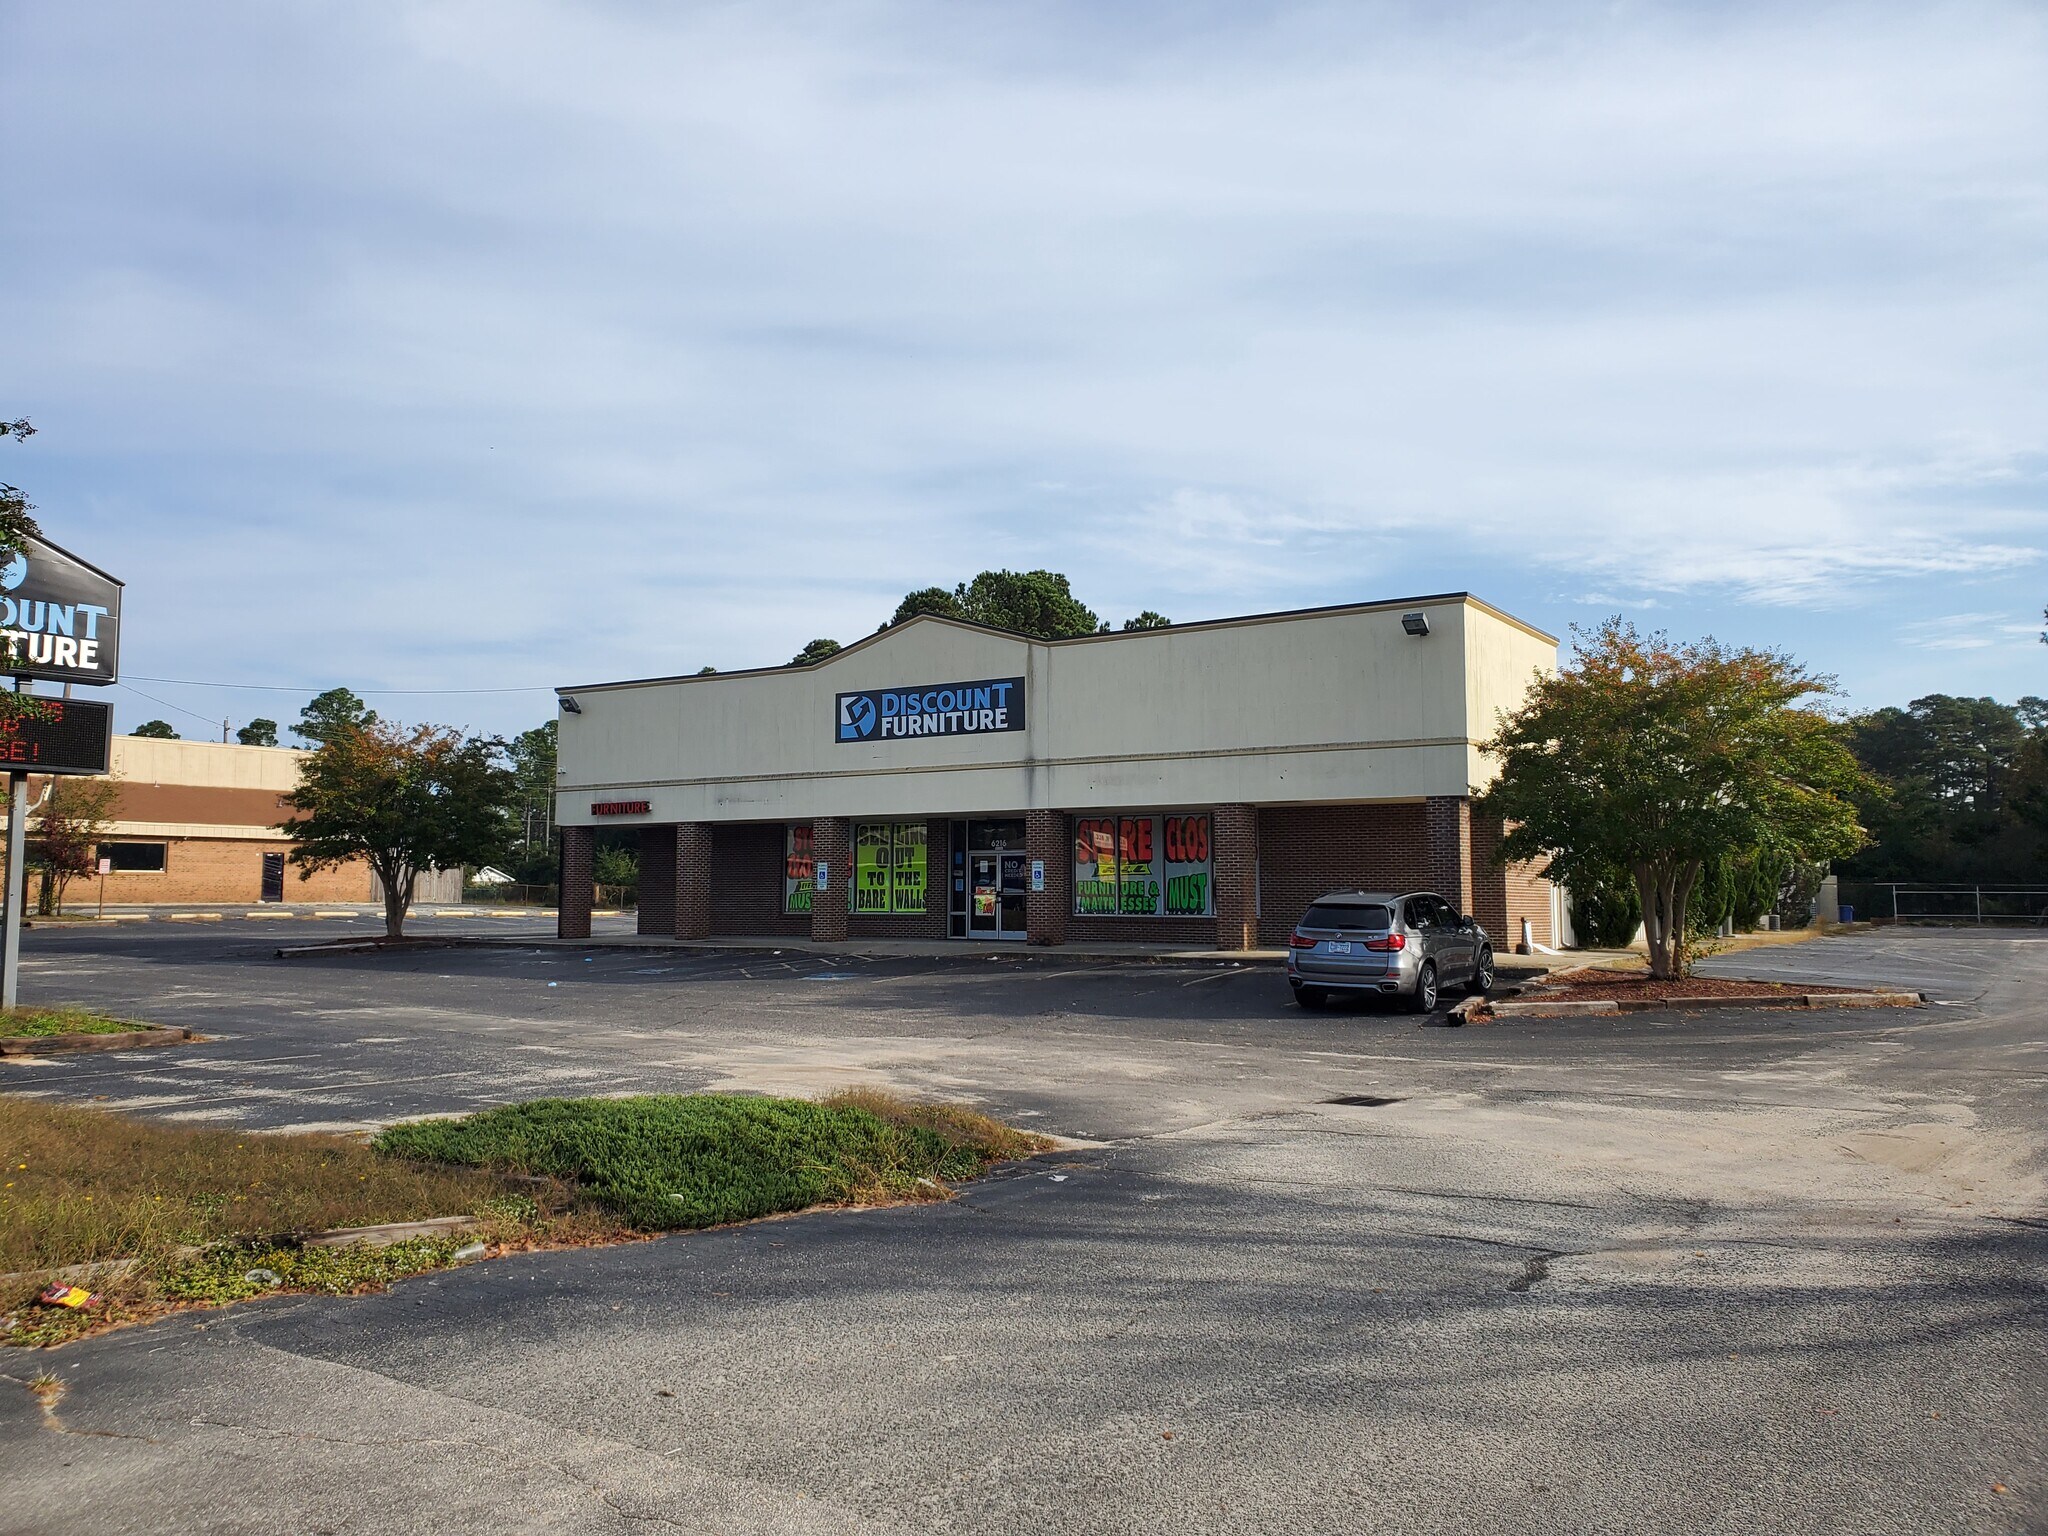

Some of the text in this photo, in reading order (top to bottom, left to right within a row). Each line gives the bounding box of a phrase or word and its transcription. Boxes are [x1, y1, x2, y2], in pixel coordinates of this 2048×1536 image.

[881, 682, 1013, 716] DISCOUNT
[881, 708, 1008, 737] FURNITURE
[1077, 818, 1152, 863] STORE
[875, 847, 915, 868] OUT
[1004, 861, 1018, 869] NO
[867, 871, 921, 886] TO THE
[1077, 881, 1161, 897] FURNITURE &
[858, 889, 885, 909] BARE
[895, 888, 927, 909] WALLS
[1168, 873, 1207, 912] MUST
[1080, 897, 1158, 912] MATTRESSES
